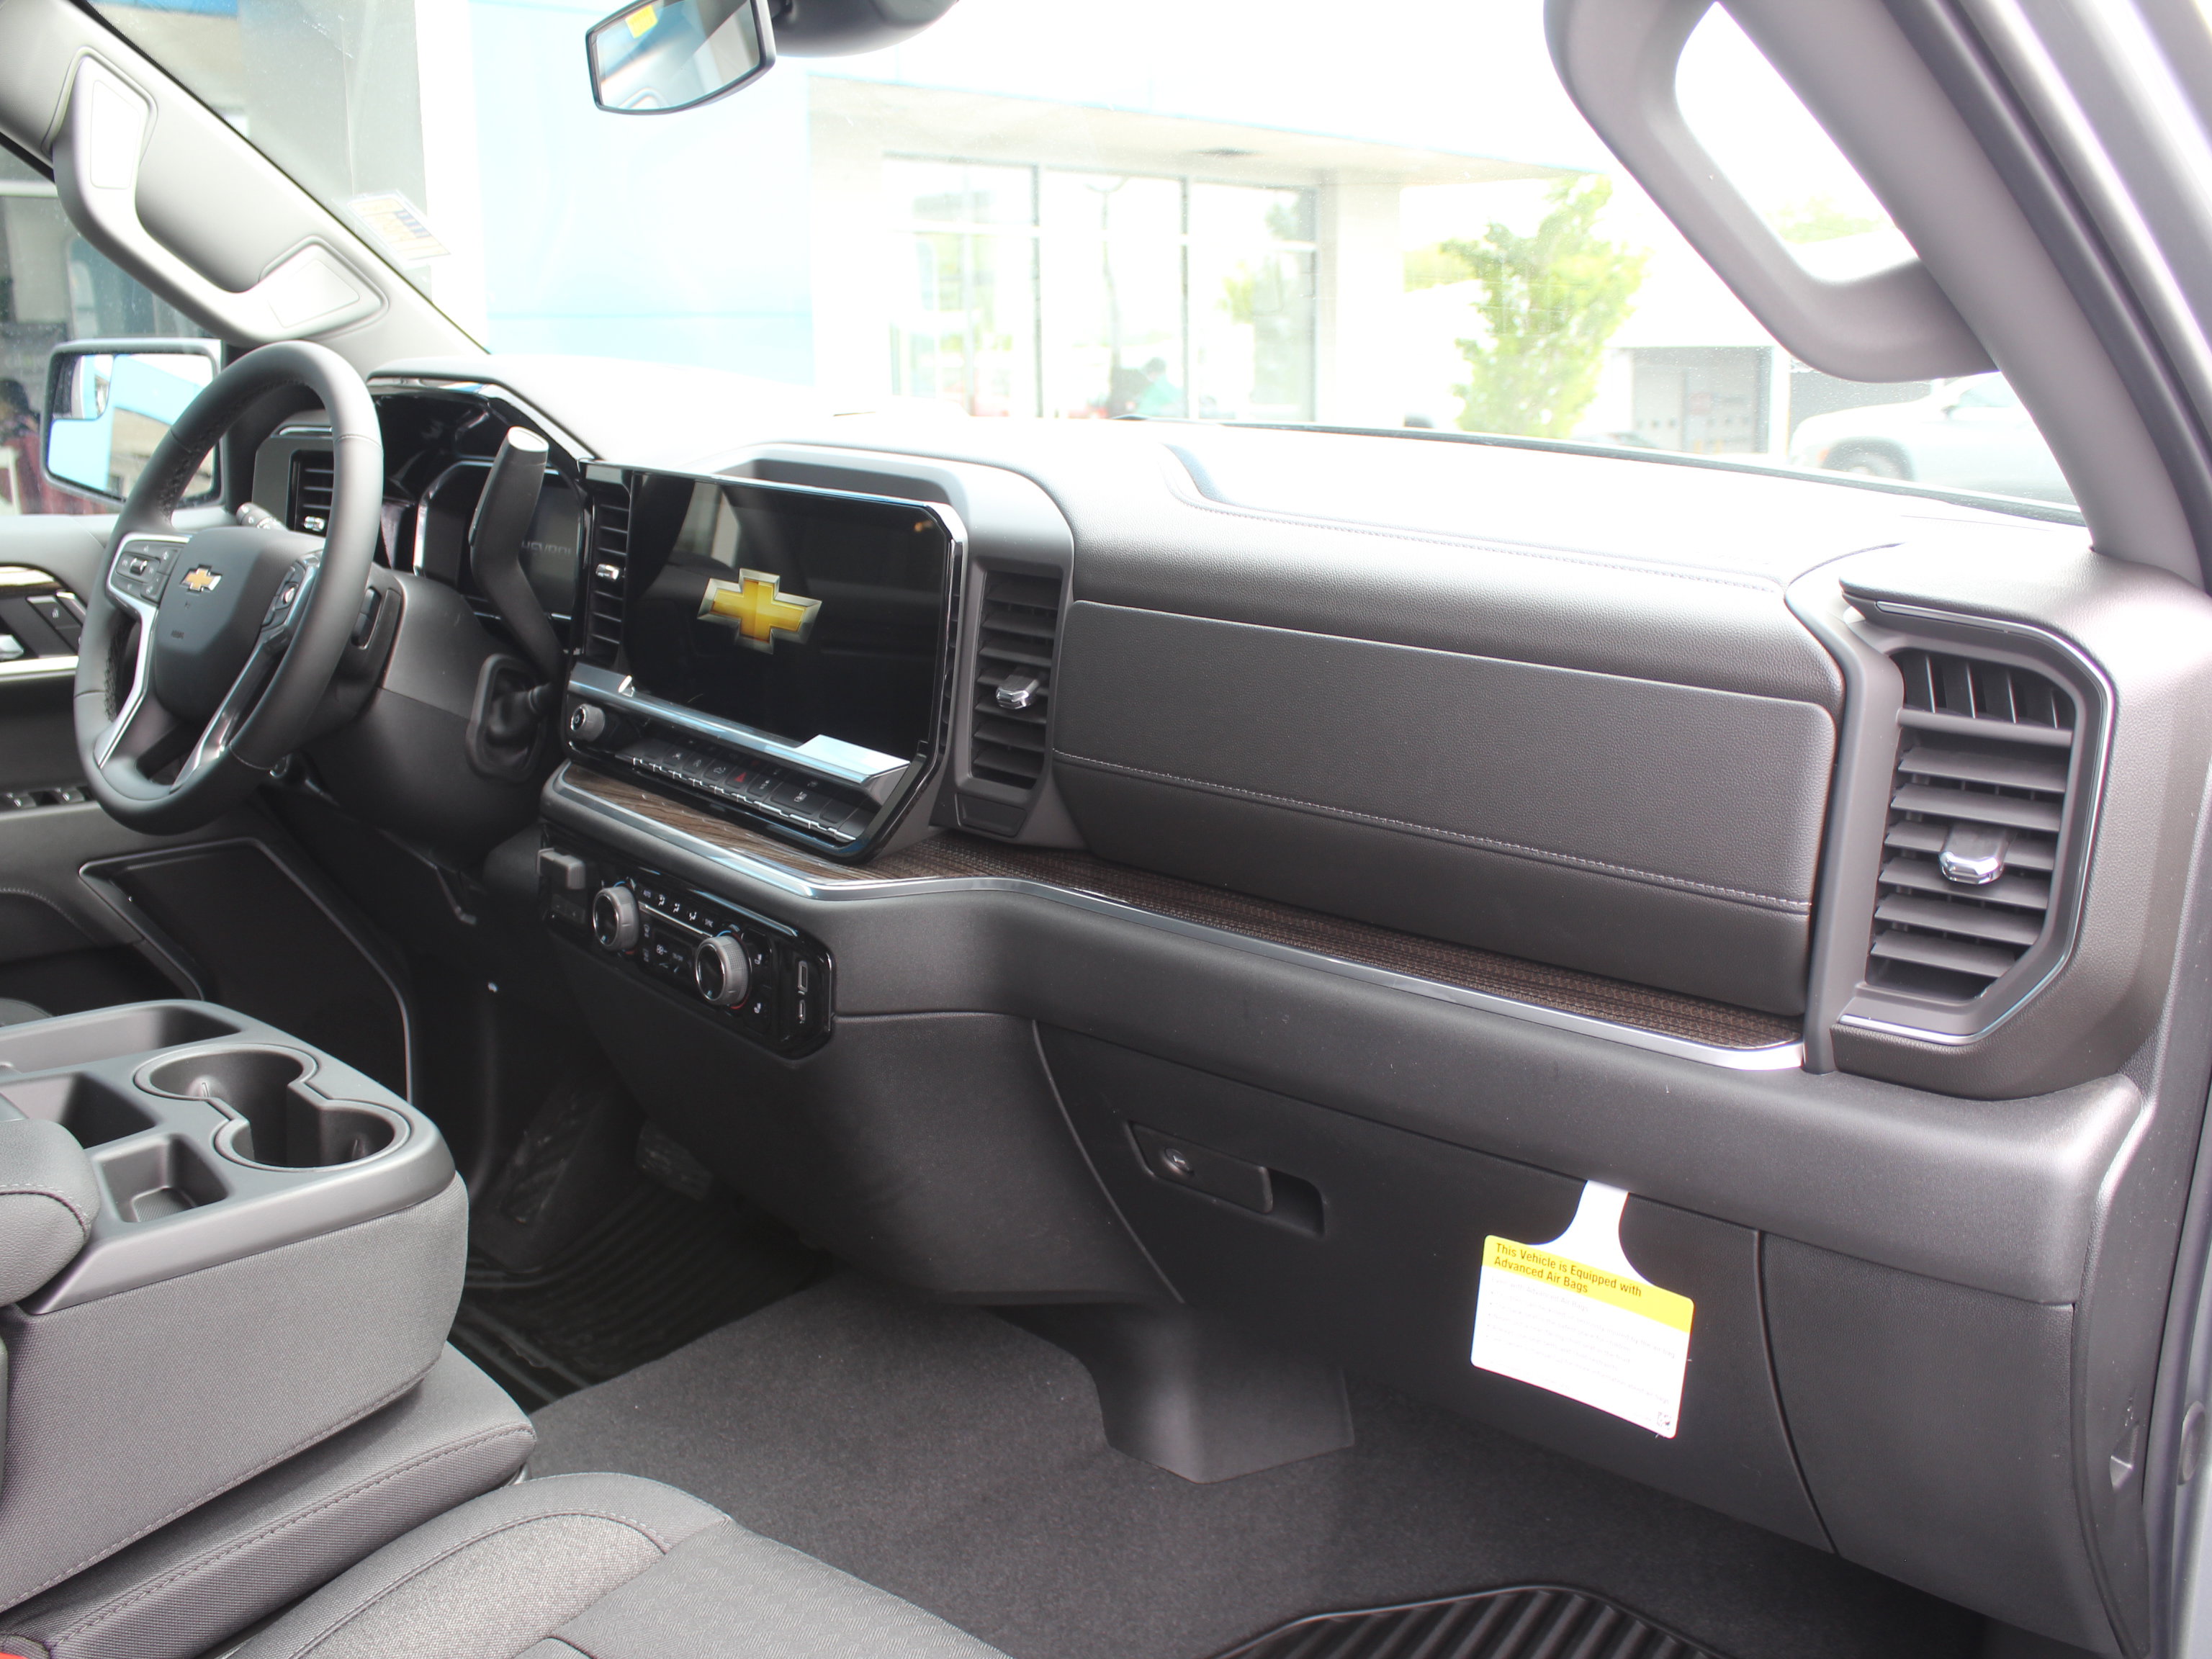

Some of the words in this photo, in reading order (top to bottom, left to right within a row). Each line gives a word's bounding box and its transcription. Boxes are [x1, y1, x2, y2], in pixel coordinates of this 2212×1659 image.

[1494, 1256, 1543, 1279] Advanced
[1547, 1272, 1561, 1284] Air
[1563, 1277, 1588, 1293] Bags
[1496, 1243, 1516, 1257] This
[1520, 1249, 1556, 1269] Vehicle
[1559, 1262, 1568, 1273] is
[1570, 1265, 1617, 1288] Equipped
[1619, 1282, 1642, 1298] with
